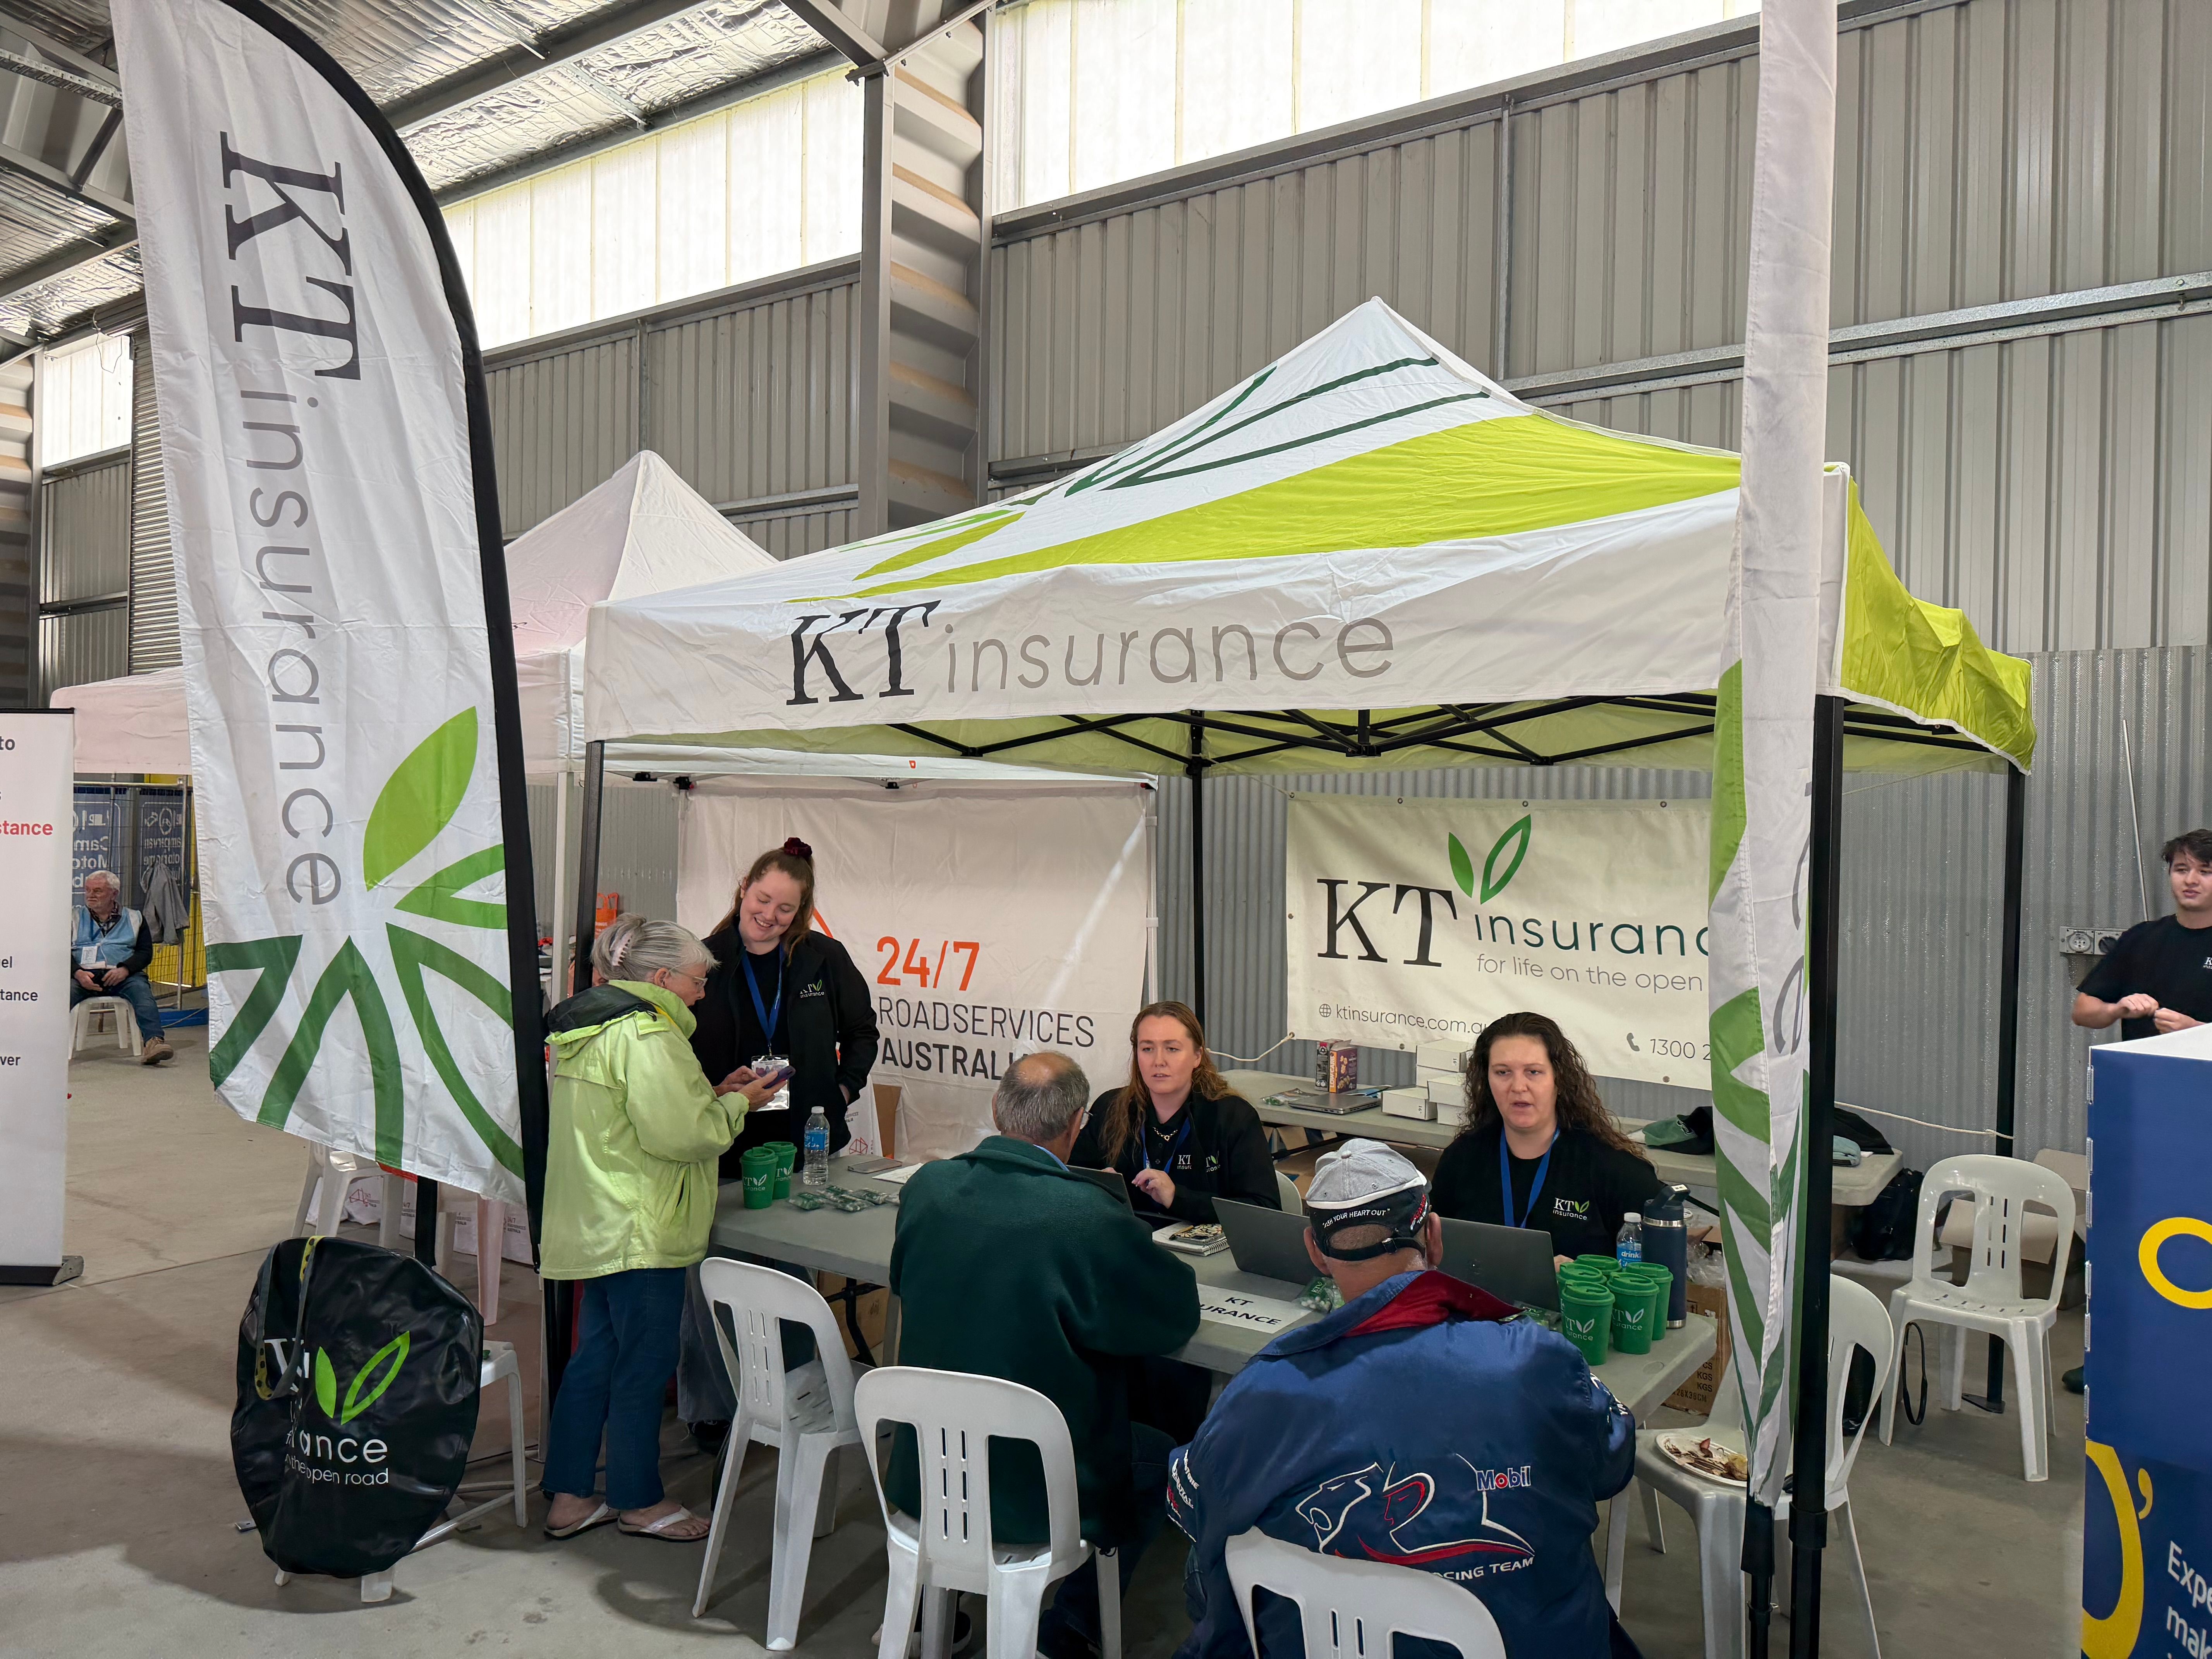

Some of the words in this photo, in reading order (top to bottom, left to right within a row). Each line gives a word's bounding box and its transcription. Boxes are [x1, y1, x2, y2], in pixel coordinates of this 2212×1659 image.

[220, 131, 361, 380] KT
[240, 390, 342, 906] insurance
[785, 599, 942, 706] KT
[945, 617, 1394, 694] insurance
[1317, 878, 1458, 968] KT
[877, 936, 980, 991] 24/7
[1477, 953, 1506, 973] for
[1513, 956, 1543, 977] life
[1550, 966, 1579, 982] on
[1585, 966, 1626, 987] the
[1635, 973, 1703, 994] open
[879, 996, 1094, 1048] ROADSERVICES
[881, 1037, 1028, 1080] AUSTRALI
[1650, 1039, 1695, 1059] 1300
[1333, 1212, 1348, 1222] YOUR
[1349, 1209, 1370, 1218] HEART
[1553, 1209, 1587, 1221] insurance
[1554, 1197, 1574, 1212] KT
[1224, 1297, 1254, 1305] KT
[1697, 1371, 1712, 1381] KGS
[1697, 1381, 1712, 1392] KGS
[345, 1468, 389, 1486] road
[1476, 1466, 1531, 1491] Mobil
[1432, 1566, 1484, 1581] CING
[1489, 1557, 1534, 1573] TEAM
